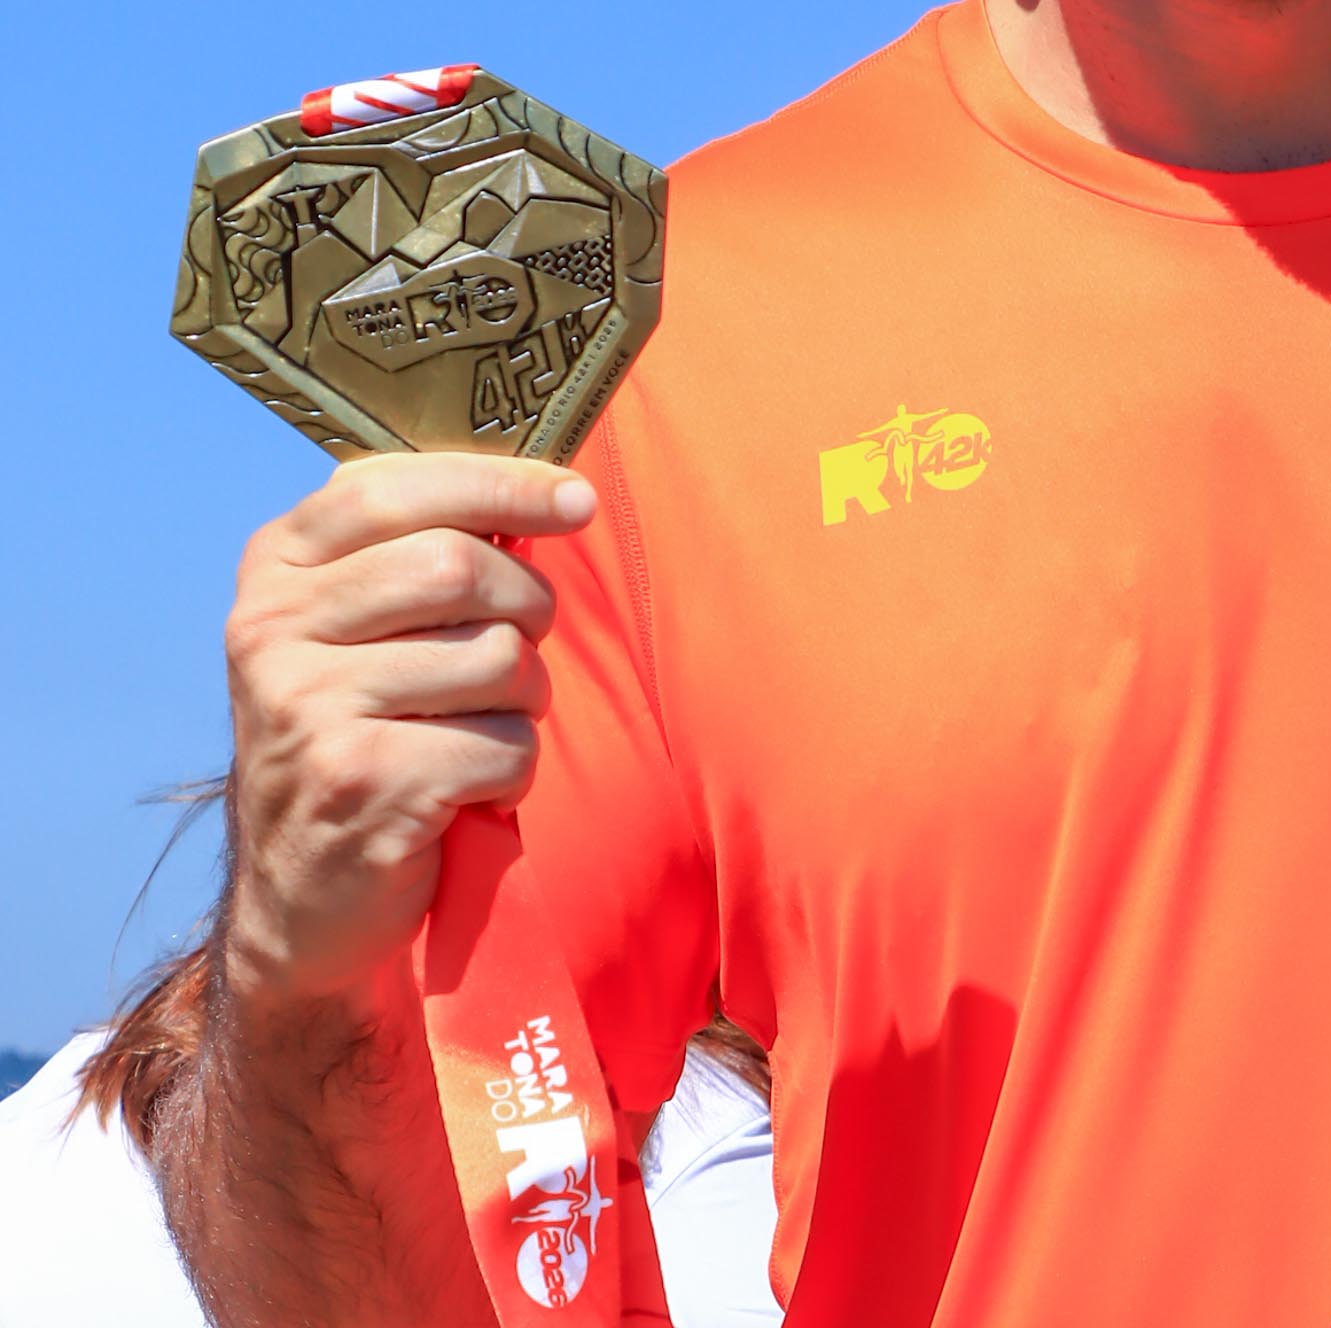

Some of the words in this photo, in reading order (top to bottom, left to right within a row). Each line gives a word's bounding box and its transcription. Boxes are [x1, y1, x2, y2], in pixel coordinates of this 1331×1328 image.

[346, 299, 402, 324] MARA
[353, 315, 405, 336] TONA
[381, 329, 409, 350] DO
[558, 386, 575, 408] RIO
[560, 409, 594, 456] CORRE
[592, 388, 608, 408] EM
[504, 1030, 546, 1118] TONA
[527, 1015, 574, 1114] MARA
[485, 1078, 517, 1122] DO
[536, 1229, 568, 1308] 2026
